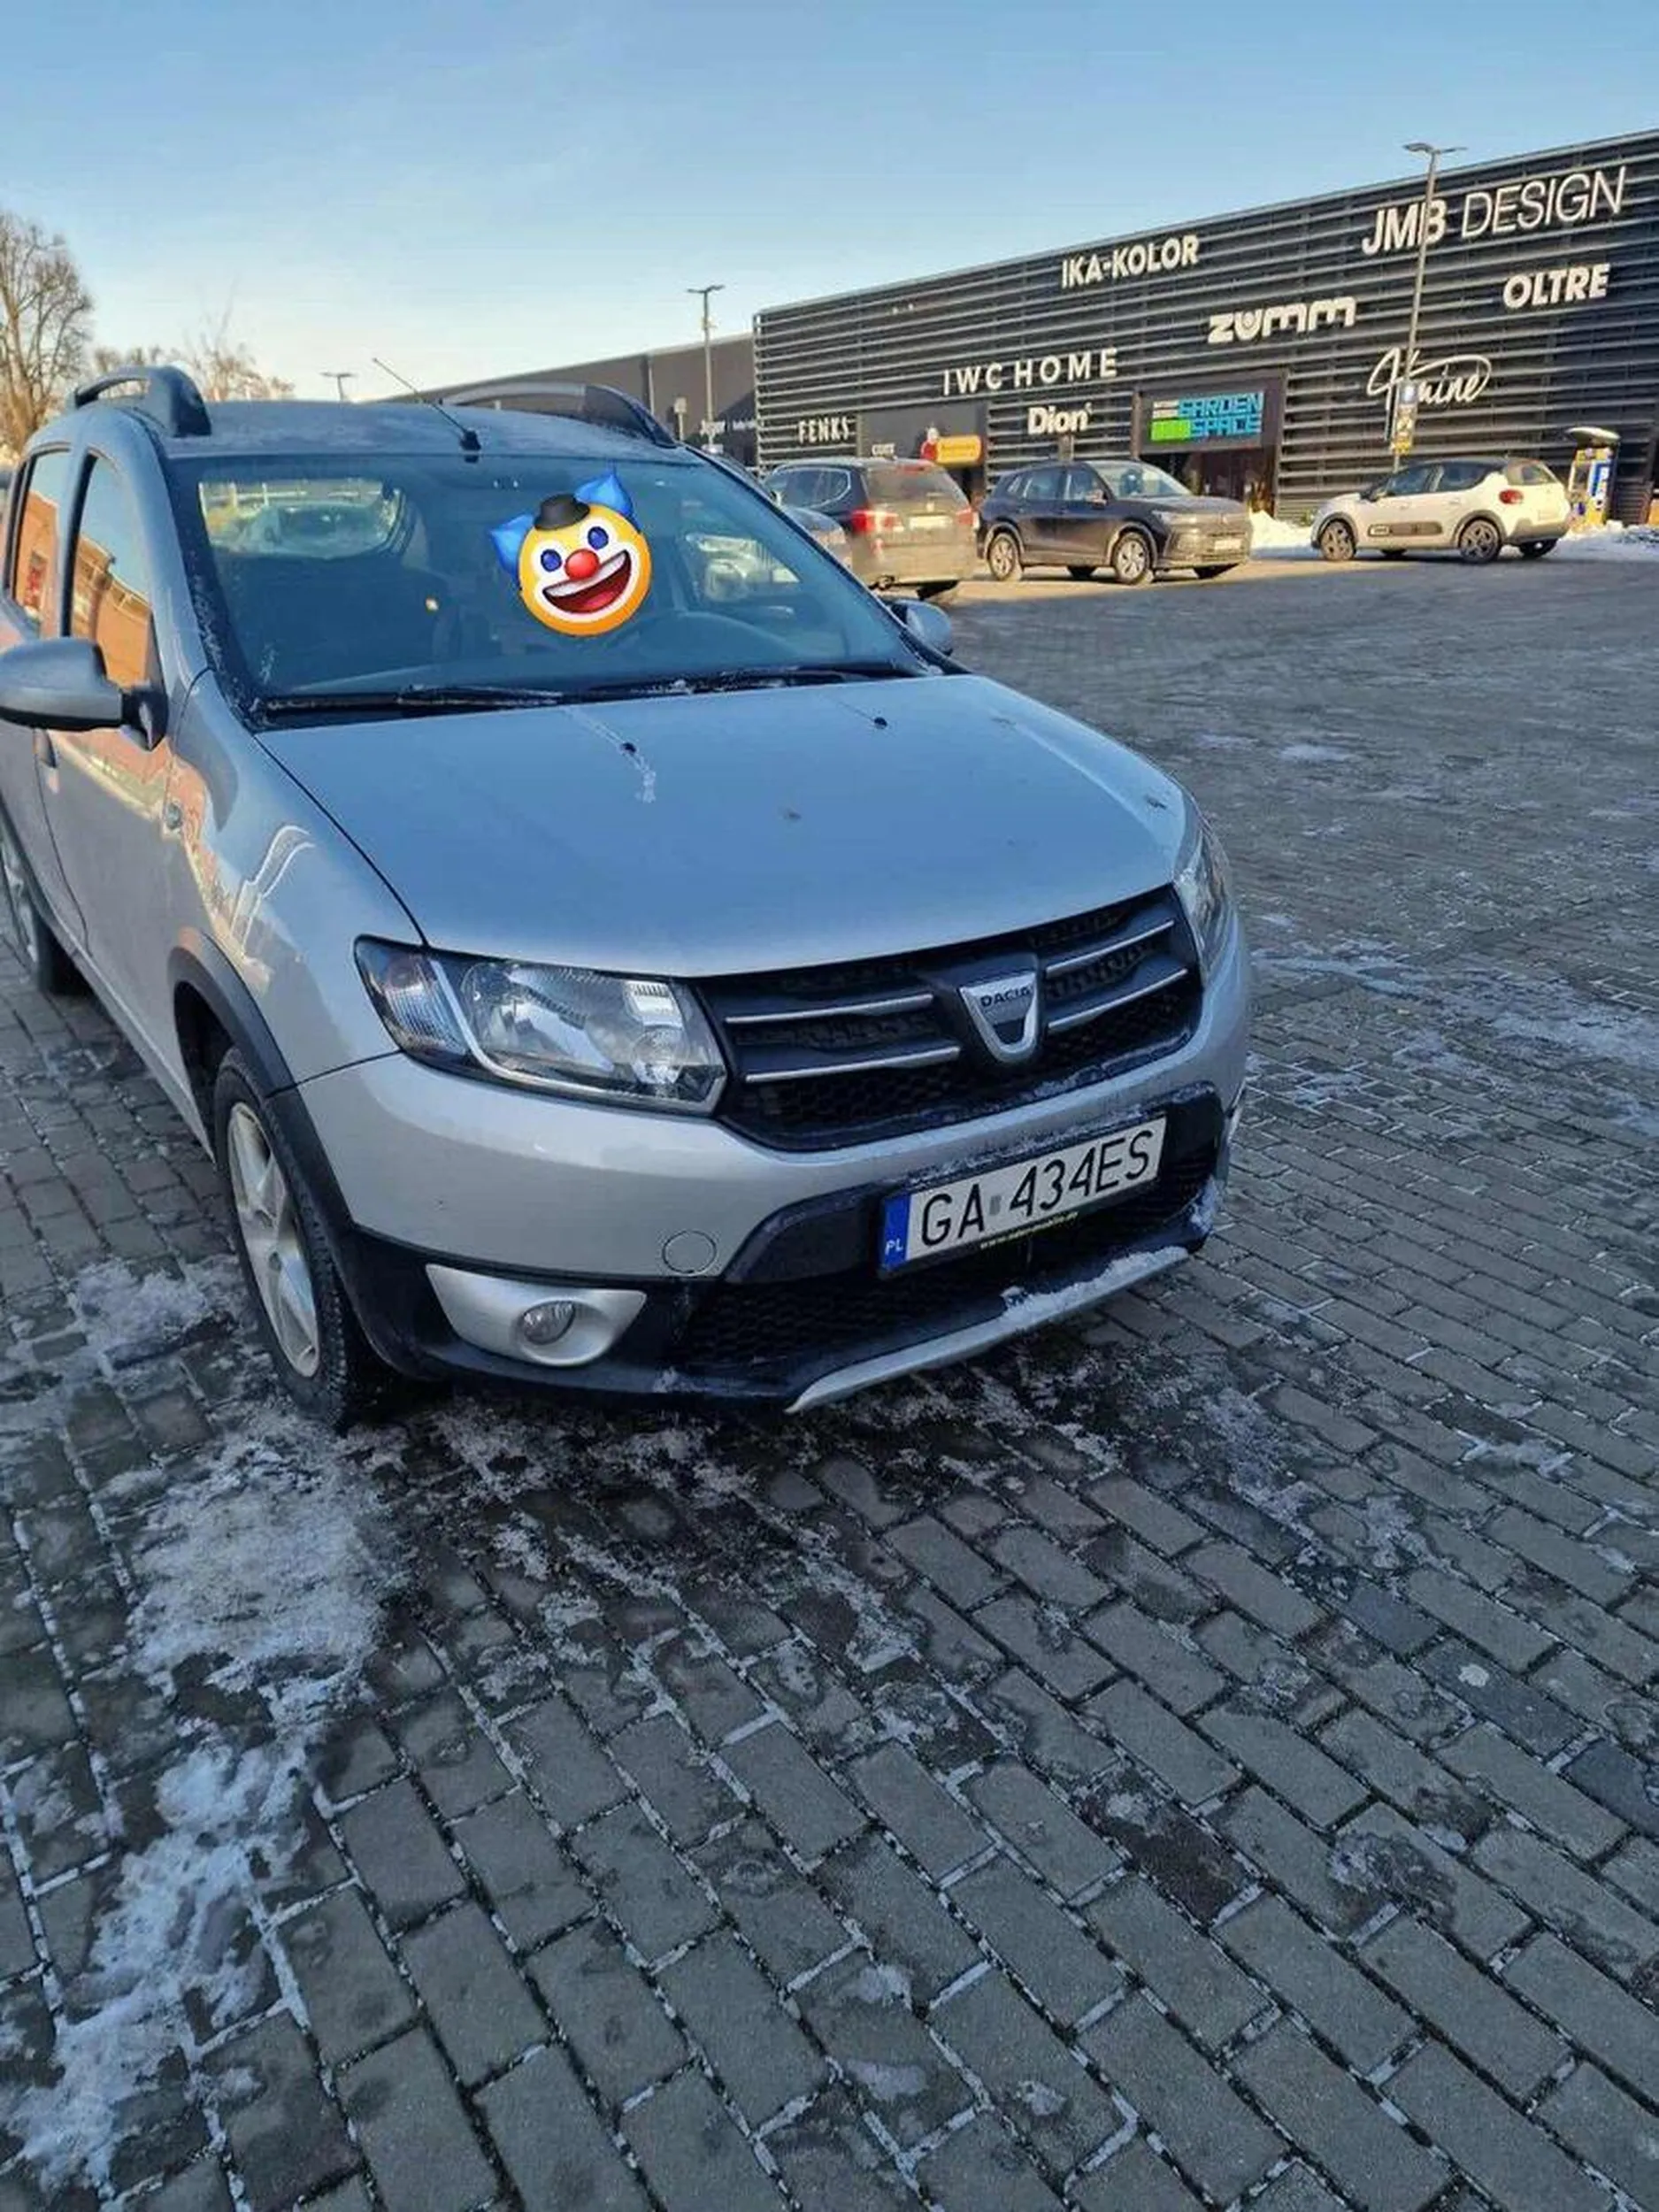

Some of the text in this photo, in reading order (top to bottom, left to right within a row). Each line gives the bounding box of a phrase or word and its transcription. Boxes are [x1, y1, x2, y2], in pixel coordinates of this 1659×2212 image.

[1362, 165, 1626, 255] JMB DESIGN
[1062, 234, 1200, 288] IKA-KOLOR
[1502, 263, 1610, 308] OLTRE
[1014, 347, 1118, 388] HOME
[1178, 392, 1263, 420] GARDEN
[797, 416, 850, 443] FENKS
[1189, 413, 1262, 440] SPACE
[980, 986, 1033, 1007] DACIA
[920, 1183, 985, 1246] GA
[1009, 1129, 1154, 1217] 434ES
[885, 1239, 903, 1256] PL
